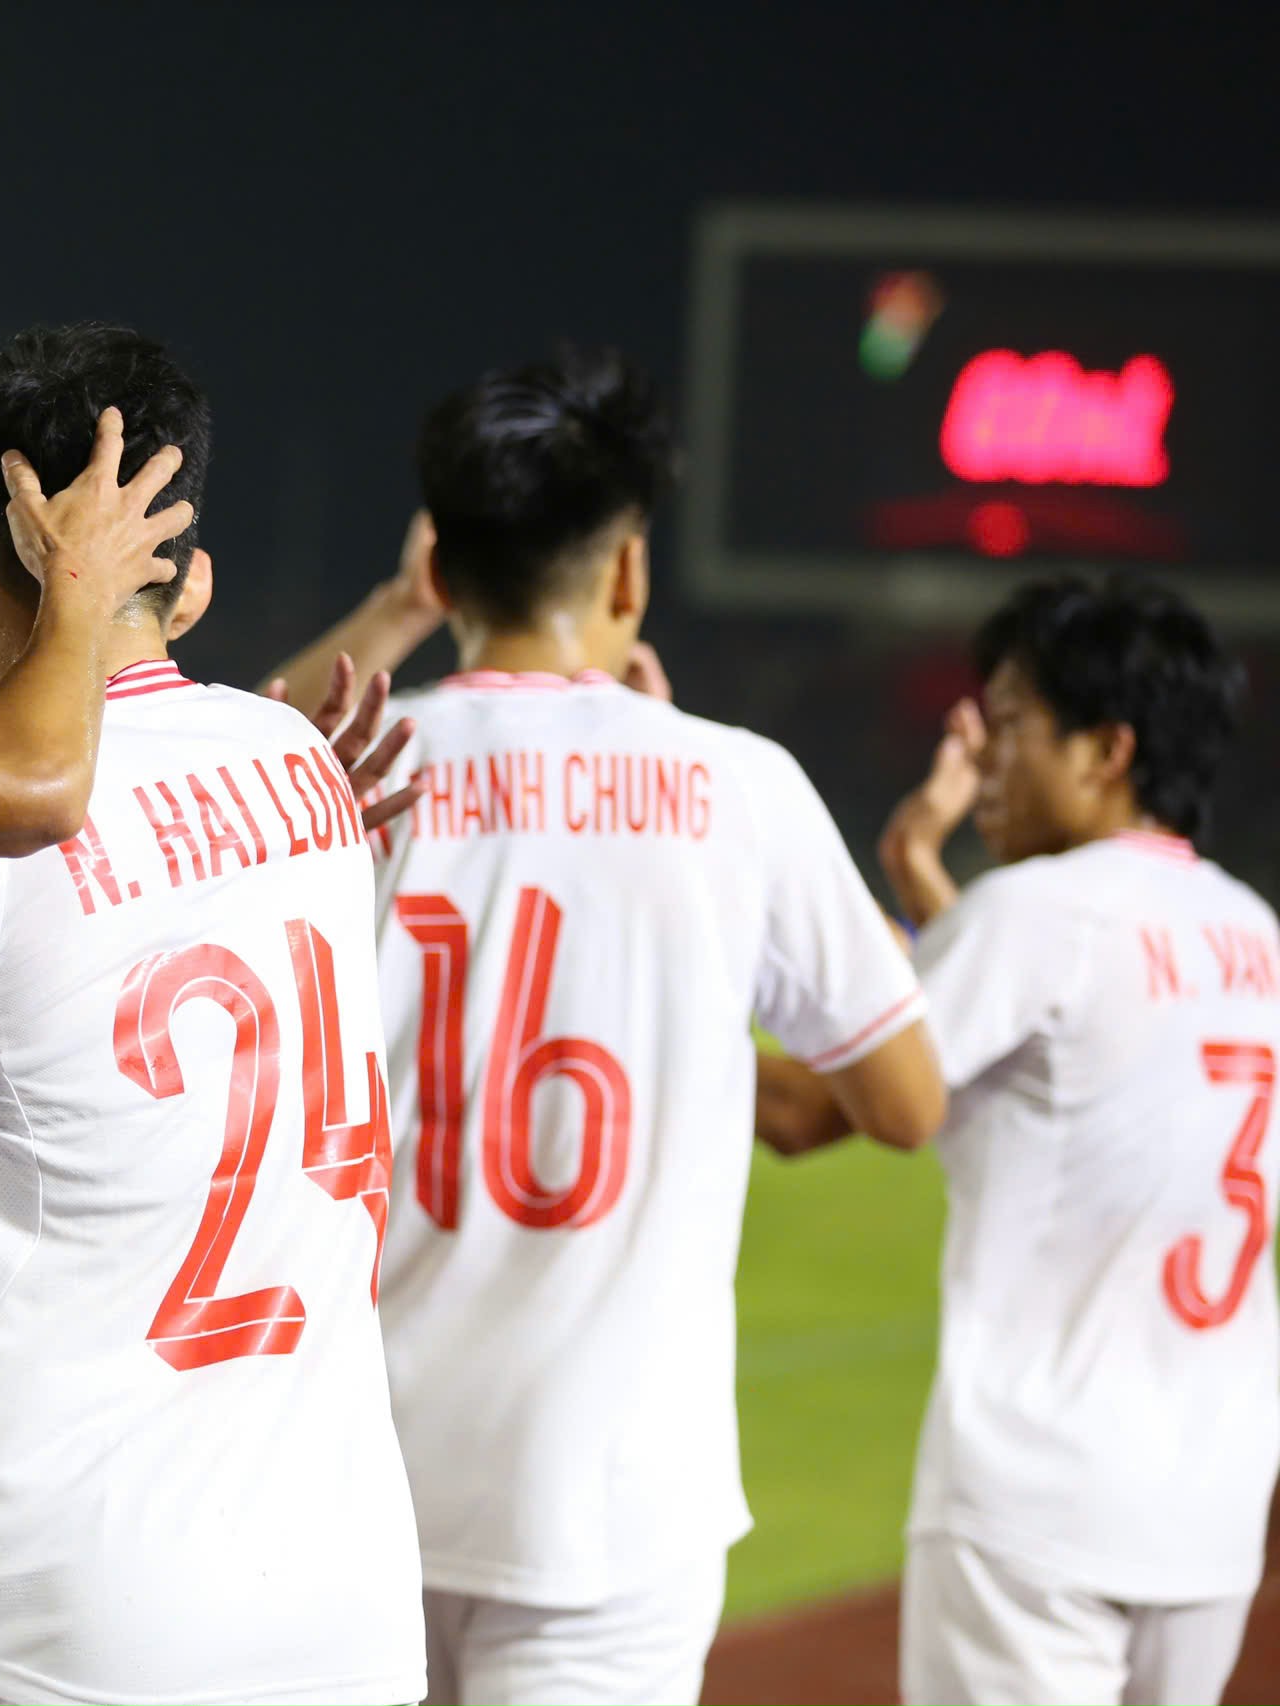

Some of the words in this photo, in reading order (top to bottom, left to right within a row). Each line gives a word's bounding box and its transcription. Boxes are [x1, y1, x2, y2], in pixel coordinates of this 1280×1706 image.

[132, 766, 267, 888] HAI
[250, 744, 368, 857] LON
[564, 752, 711, 842] CHUNG
[113, 916, 393, 1371] 24
[394, 886, 632, 1234] 16
[1161, 1040, 1276, 1332] 3
